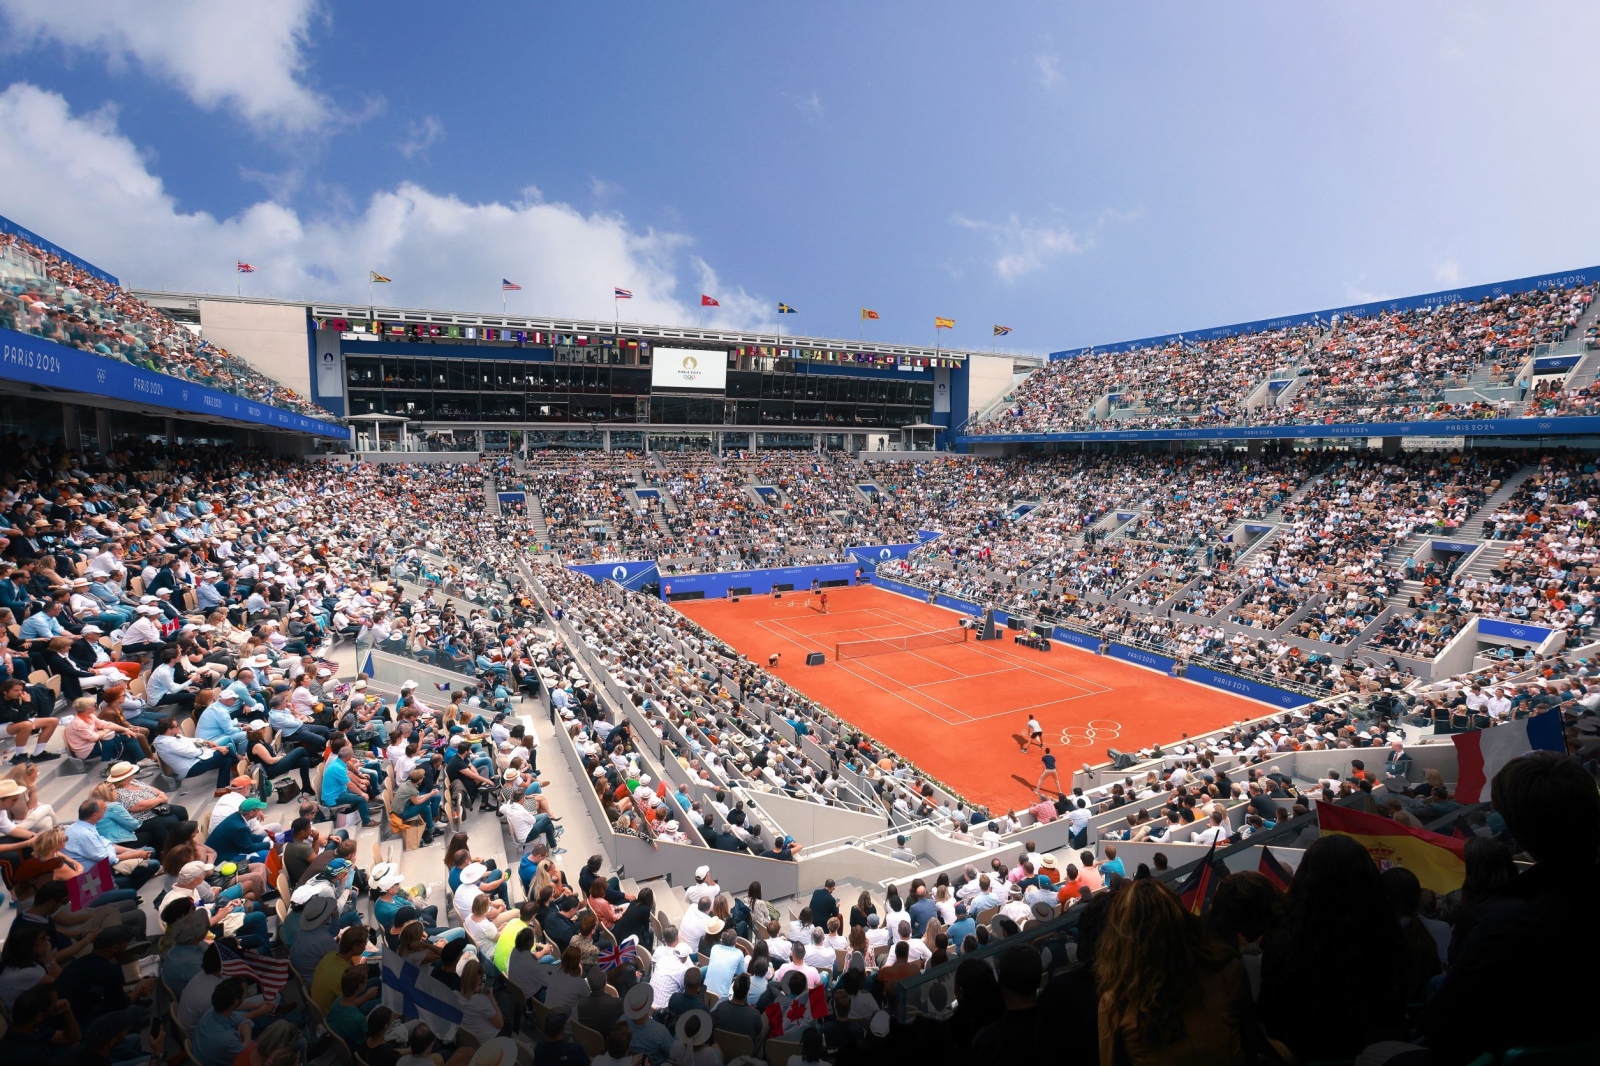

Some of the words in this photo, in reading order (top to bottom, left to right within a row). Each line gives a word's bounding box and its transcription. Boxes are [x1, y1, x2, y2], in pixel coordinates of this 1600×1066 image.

[1563, 275, 1586, 285] 2024
[1444, 293, 1461, 302] 2024
[36, 353, 61, 373] 2024
[150, 381, 164, 396] 2024
[1142, 655, 1157, 665] 2024
[1232, 681, 1251, 692] 2024
